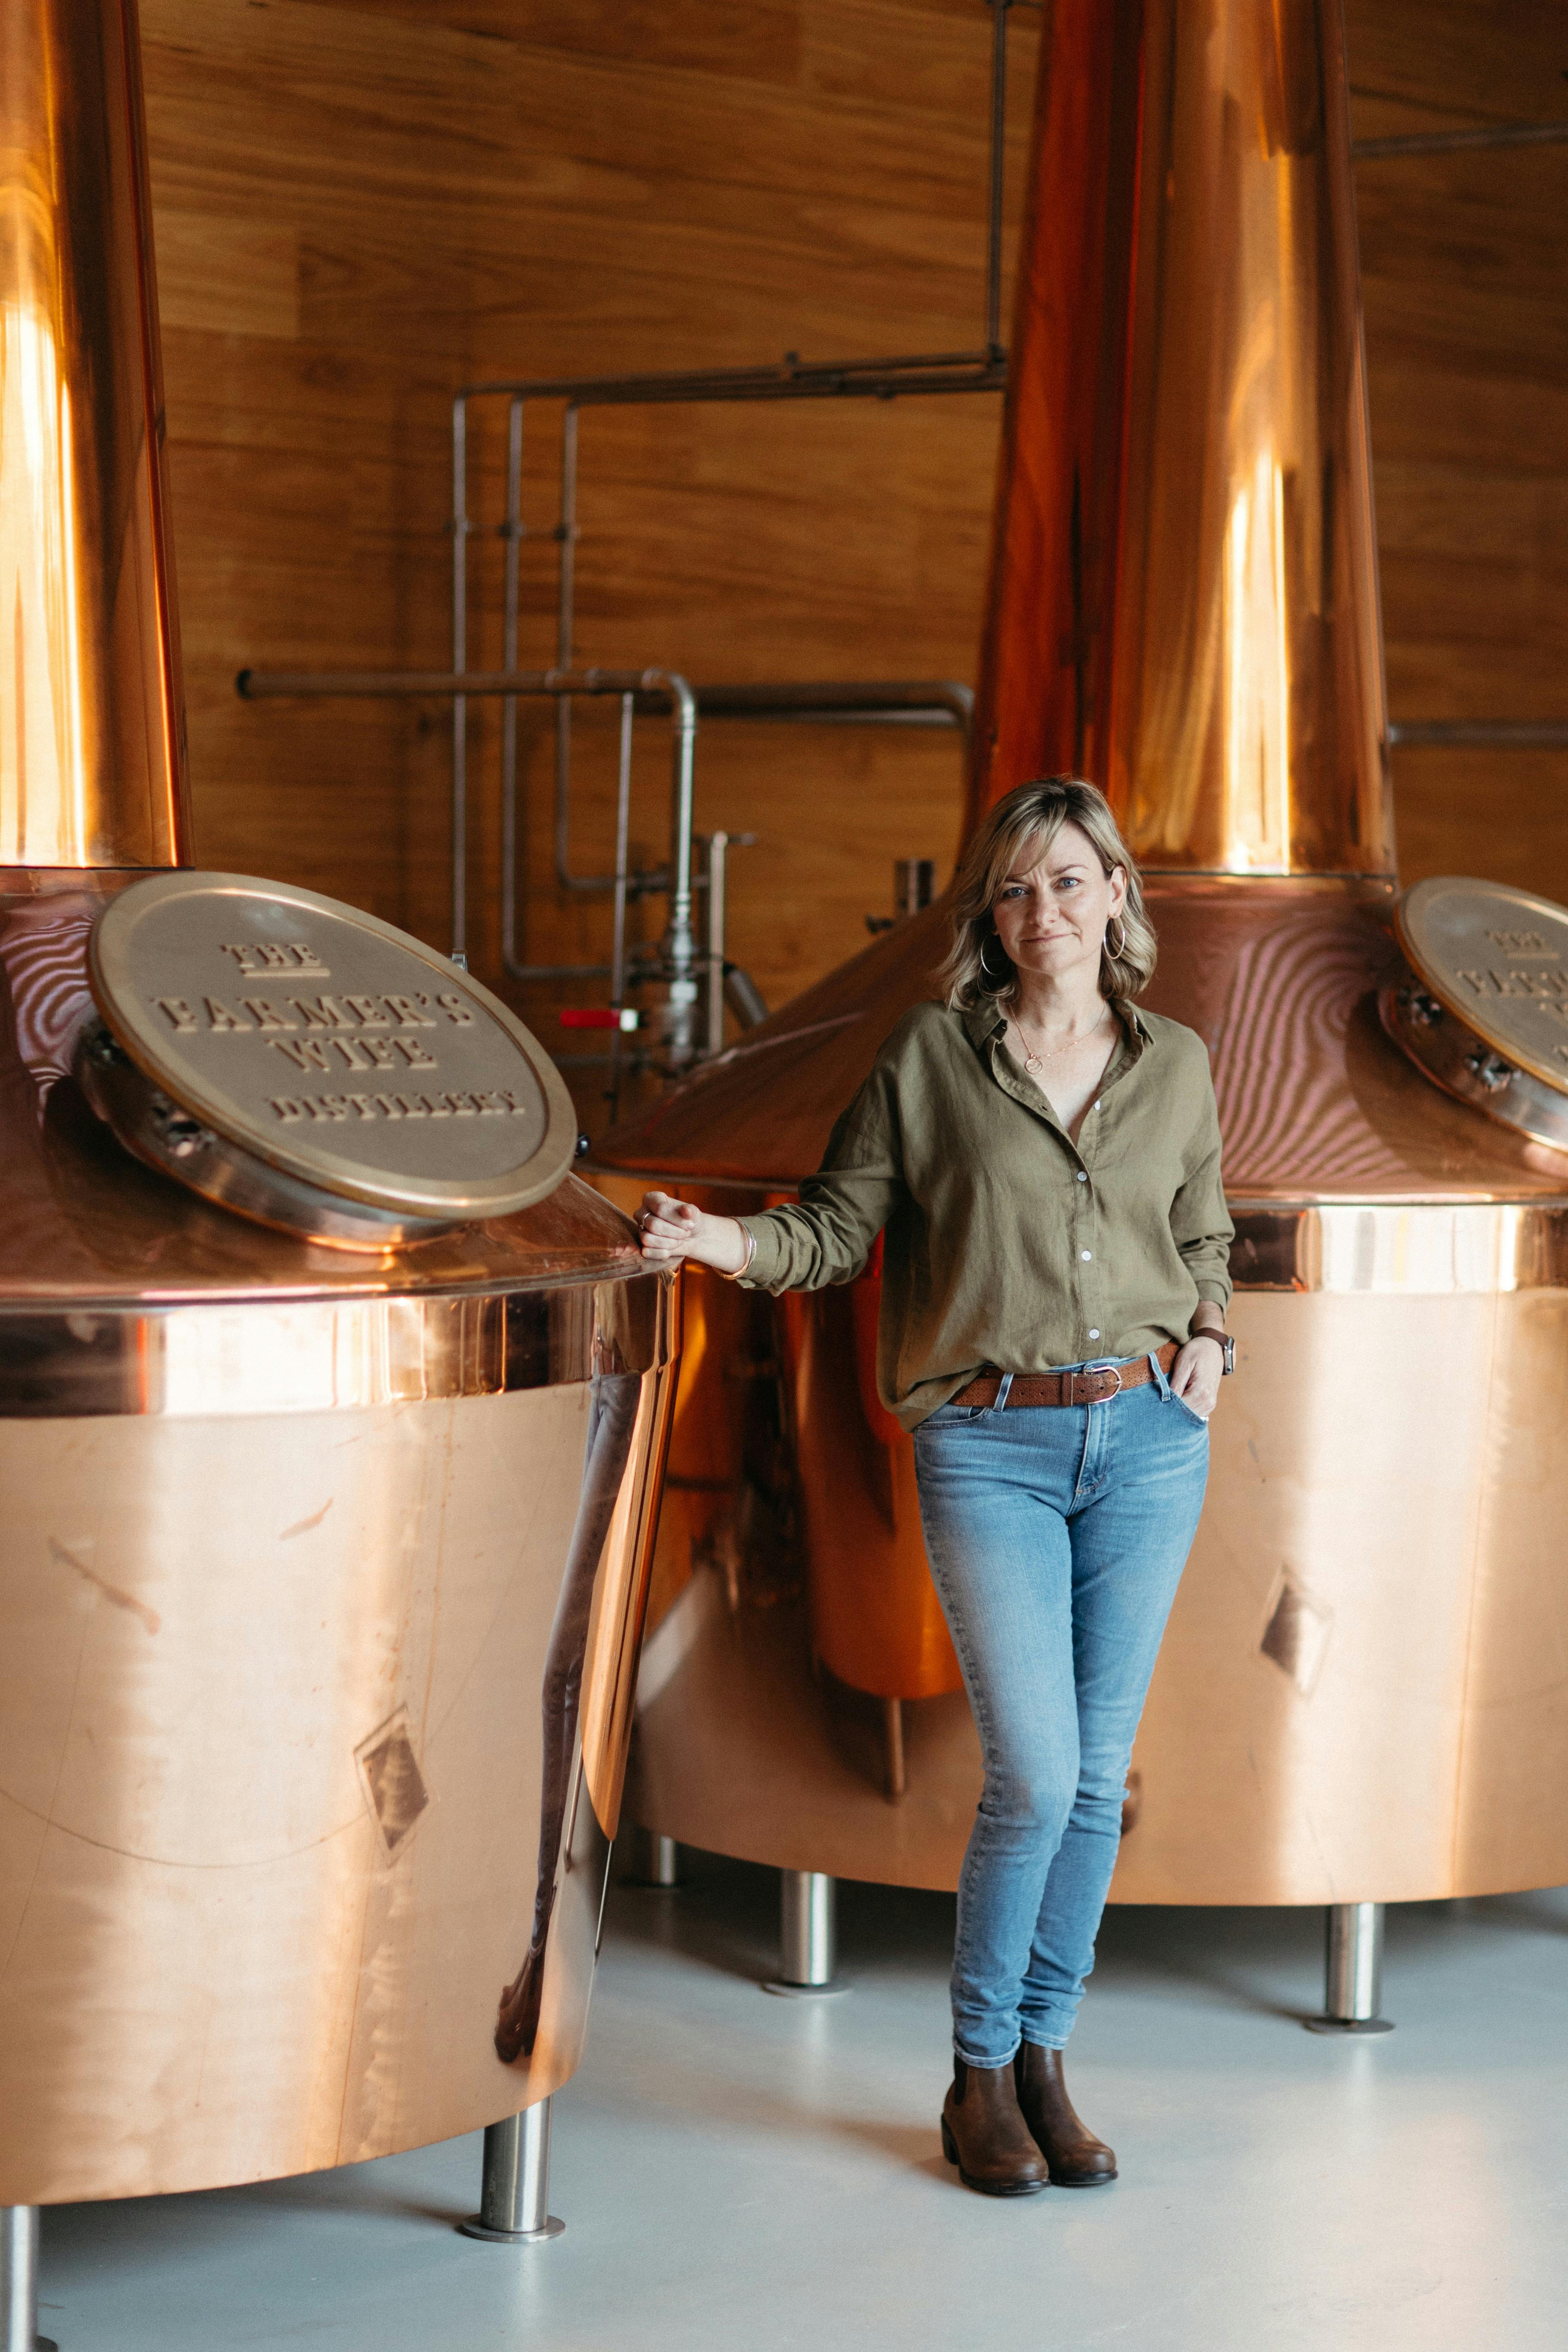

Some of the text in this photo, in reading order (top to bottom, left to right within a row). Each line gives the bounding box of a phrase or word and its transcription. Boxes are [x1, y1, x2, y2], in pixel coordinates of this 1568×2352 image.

[220, 944, 322, 968] THE
[152, 993, 475, 1031] FARMER'S
[266, 1037, 438, 1072] WIFE
[266, 1090, 526, 1122] DISTILLERY
